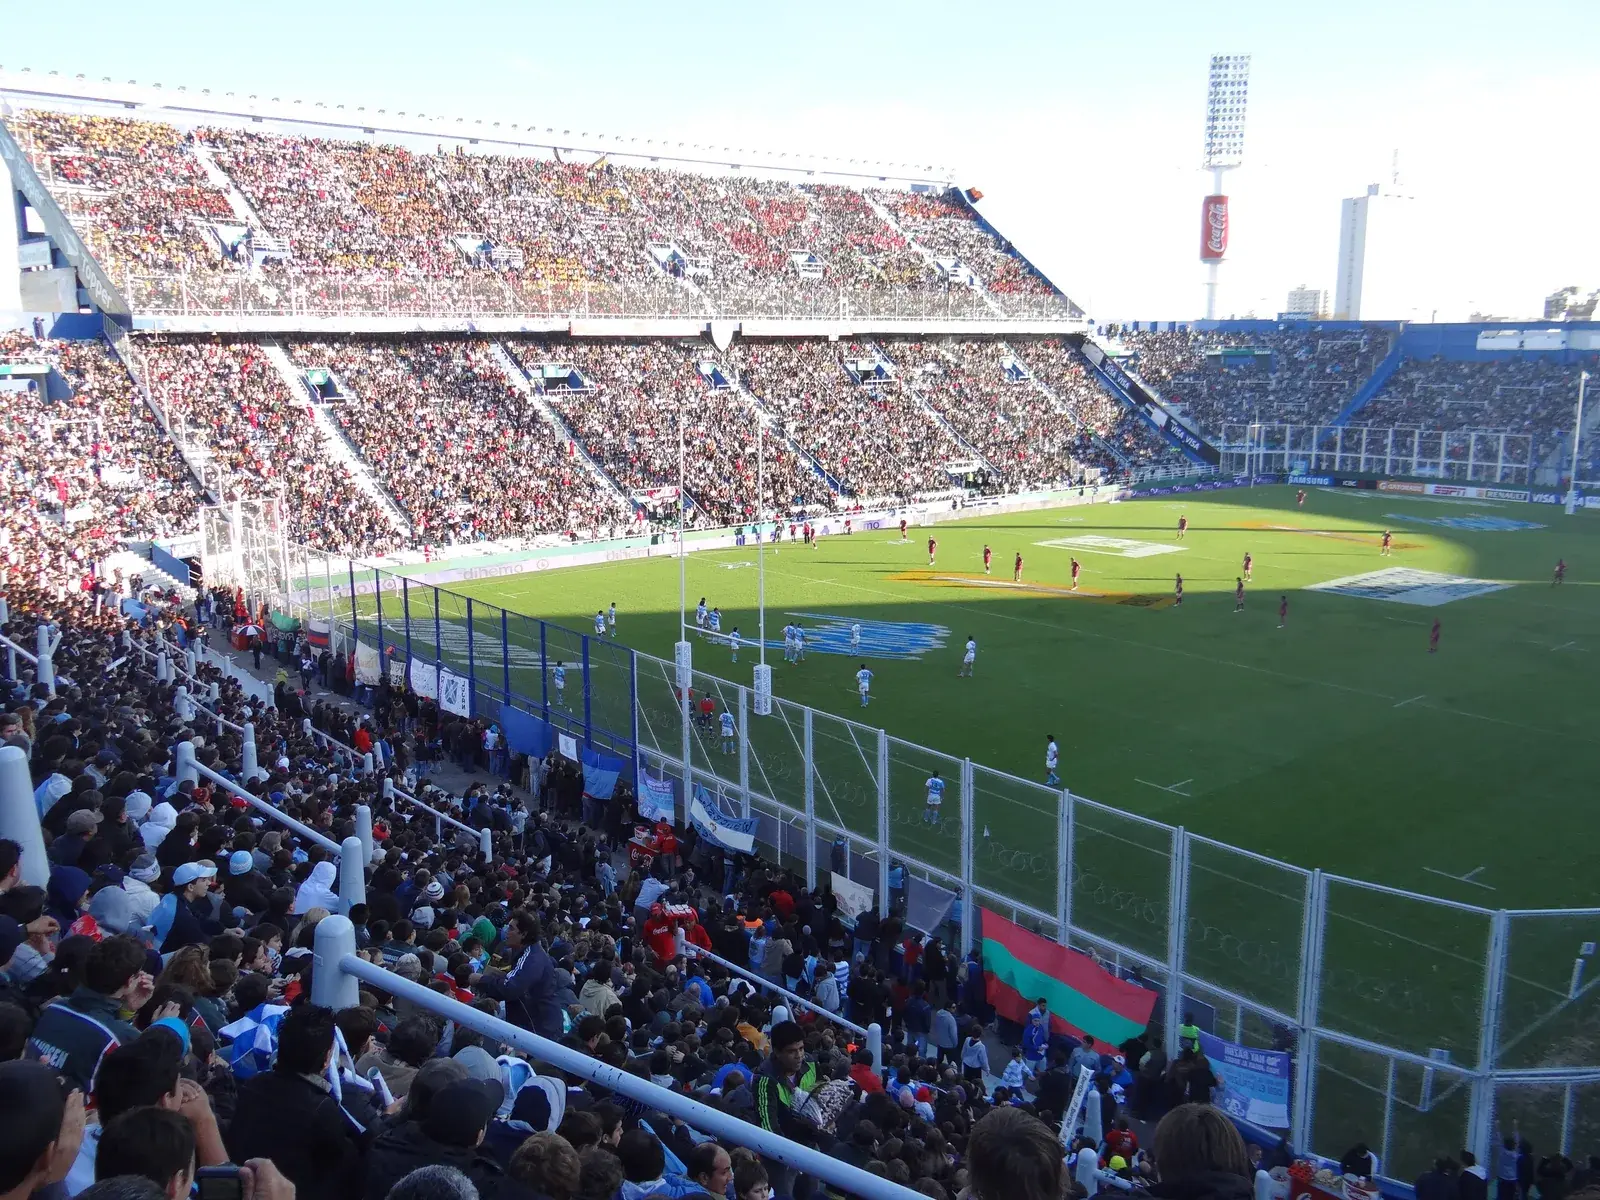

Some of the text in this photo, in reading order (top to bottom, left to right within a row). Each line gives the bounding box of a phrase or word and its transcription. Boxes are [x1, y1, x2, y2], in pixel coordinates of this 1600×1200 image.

[80, 255, 113, 309] Topper
[1104, 363, 1130, 390] VISA VISA
[1170, 424, 1201, 451] VISA VISA
[1287, 475, 1329, 486] SAMSUNG
[1433, 485, 1467, 496] ESPN
[1486, 489, 1526, 501] RENAULT
[1531, 493, 1556, 504] VISA
[1560, 495, 1585, 507] VA
